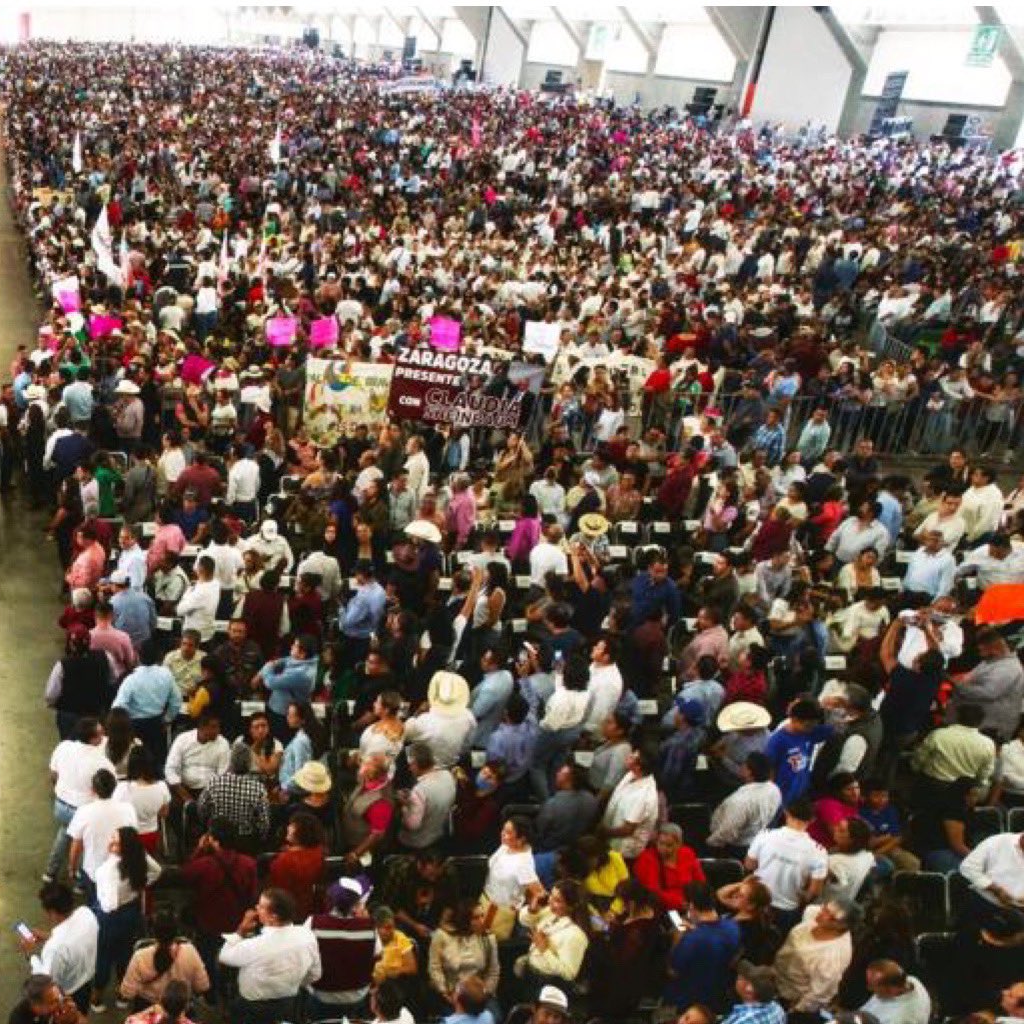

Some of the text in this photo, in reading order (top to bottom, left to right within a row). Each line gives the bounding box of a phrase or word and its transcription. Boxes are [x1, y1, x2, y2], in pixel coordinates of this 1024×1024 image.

[398, 347, 492, 374] ZARAGOZA
[396, 365, 461, 386] PRESENTE
[425, 387, 522, 414] CLAUDIA
